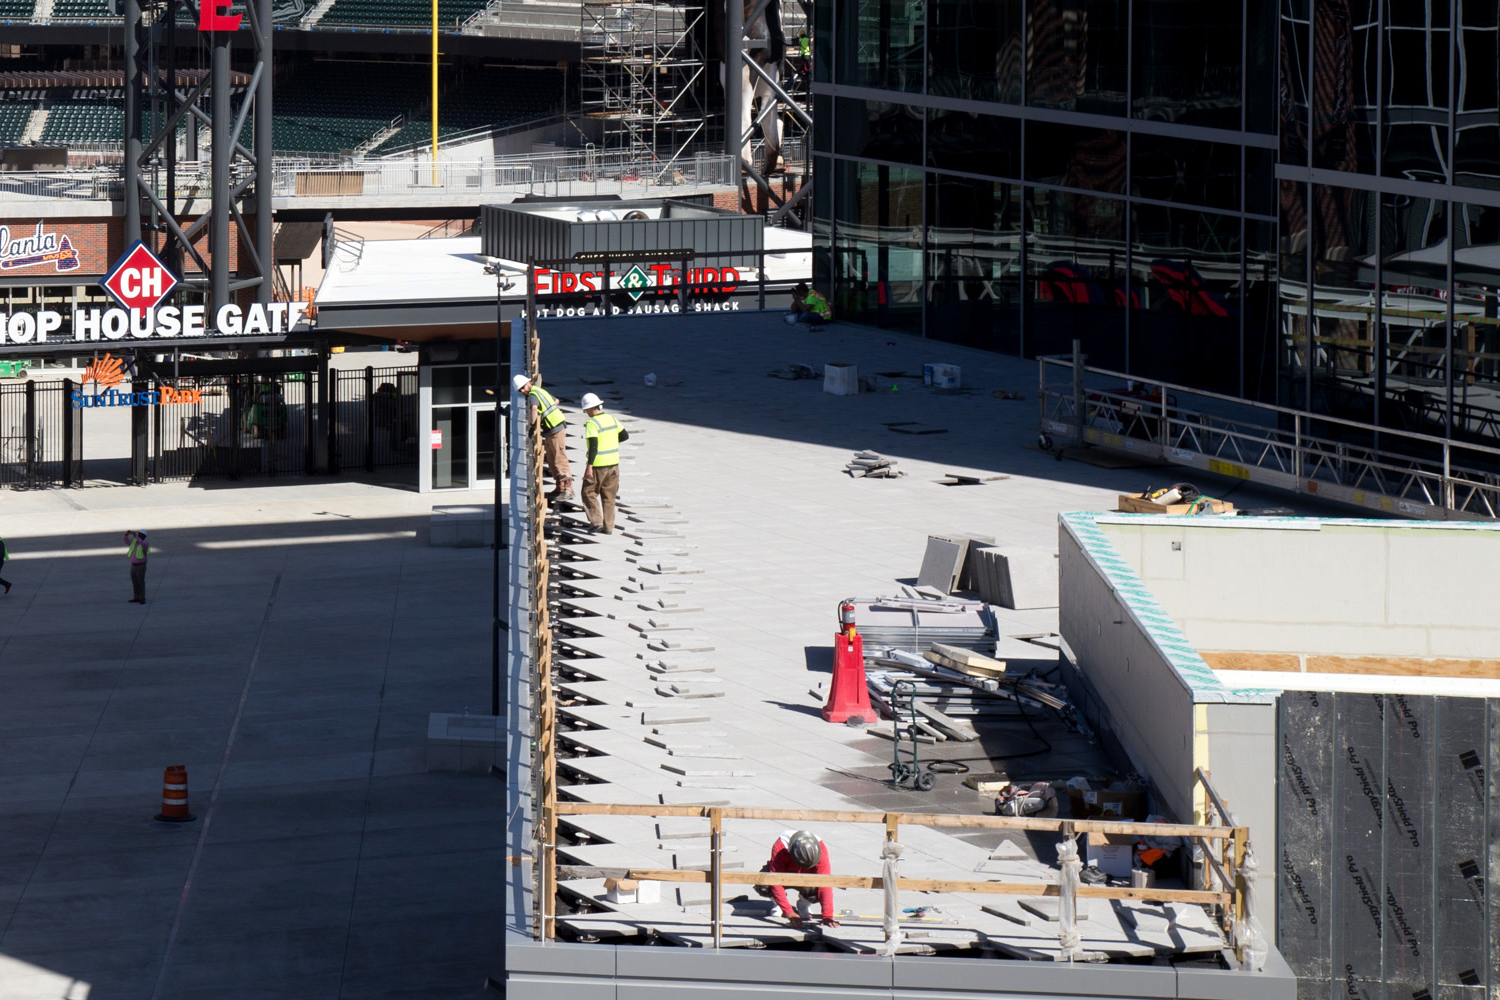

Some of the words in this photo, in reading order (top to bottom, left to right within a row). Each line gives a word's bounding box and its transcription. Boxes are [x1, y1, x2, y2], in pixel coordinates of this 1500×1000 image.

[120, 267, 162, 298] CH
[557, 308, 585, 317] DOG
[695, 301, 740, 312] SHACK
[75, 305, 205, 340] HOUSE
[1347, 746, 1360, 765] Pro
[1305, 797, 1319, 816] Pro
[1407, 829, 1420, 848] Pro
[1346, 855, 1359, 874] Pro
[1305, 906, 1318, 925] Pro
[1407, 938, 1420, 957] Pro
